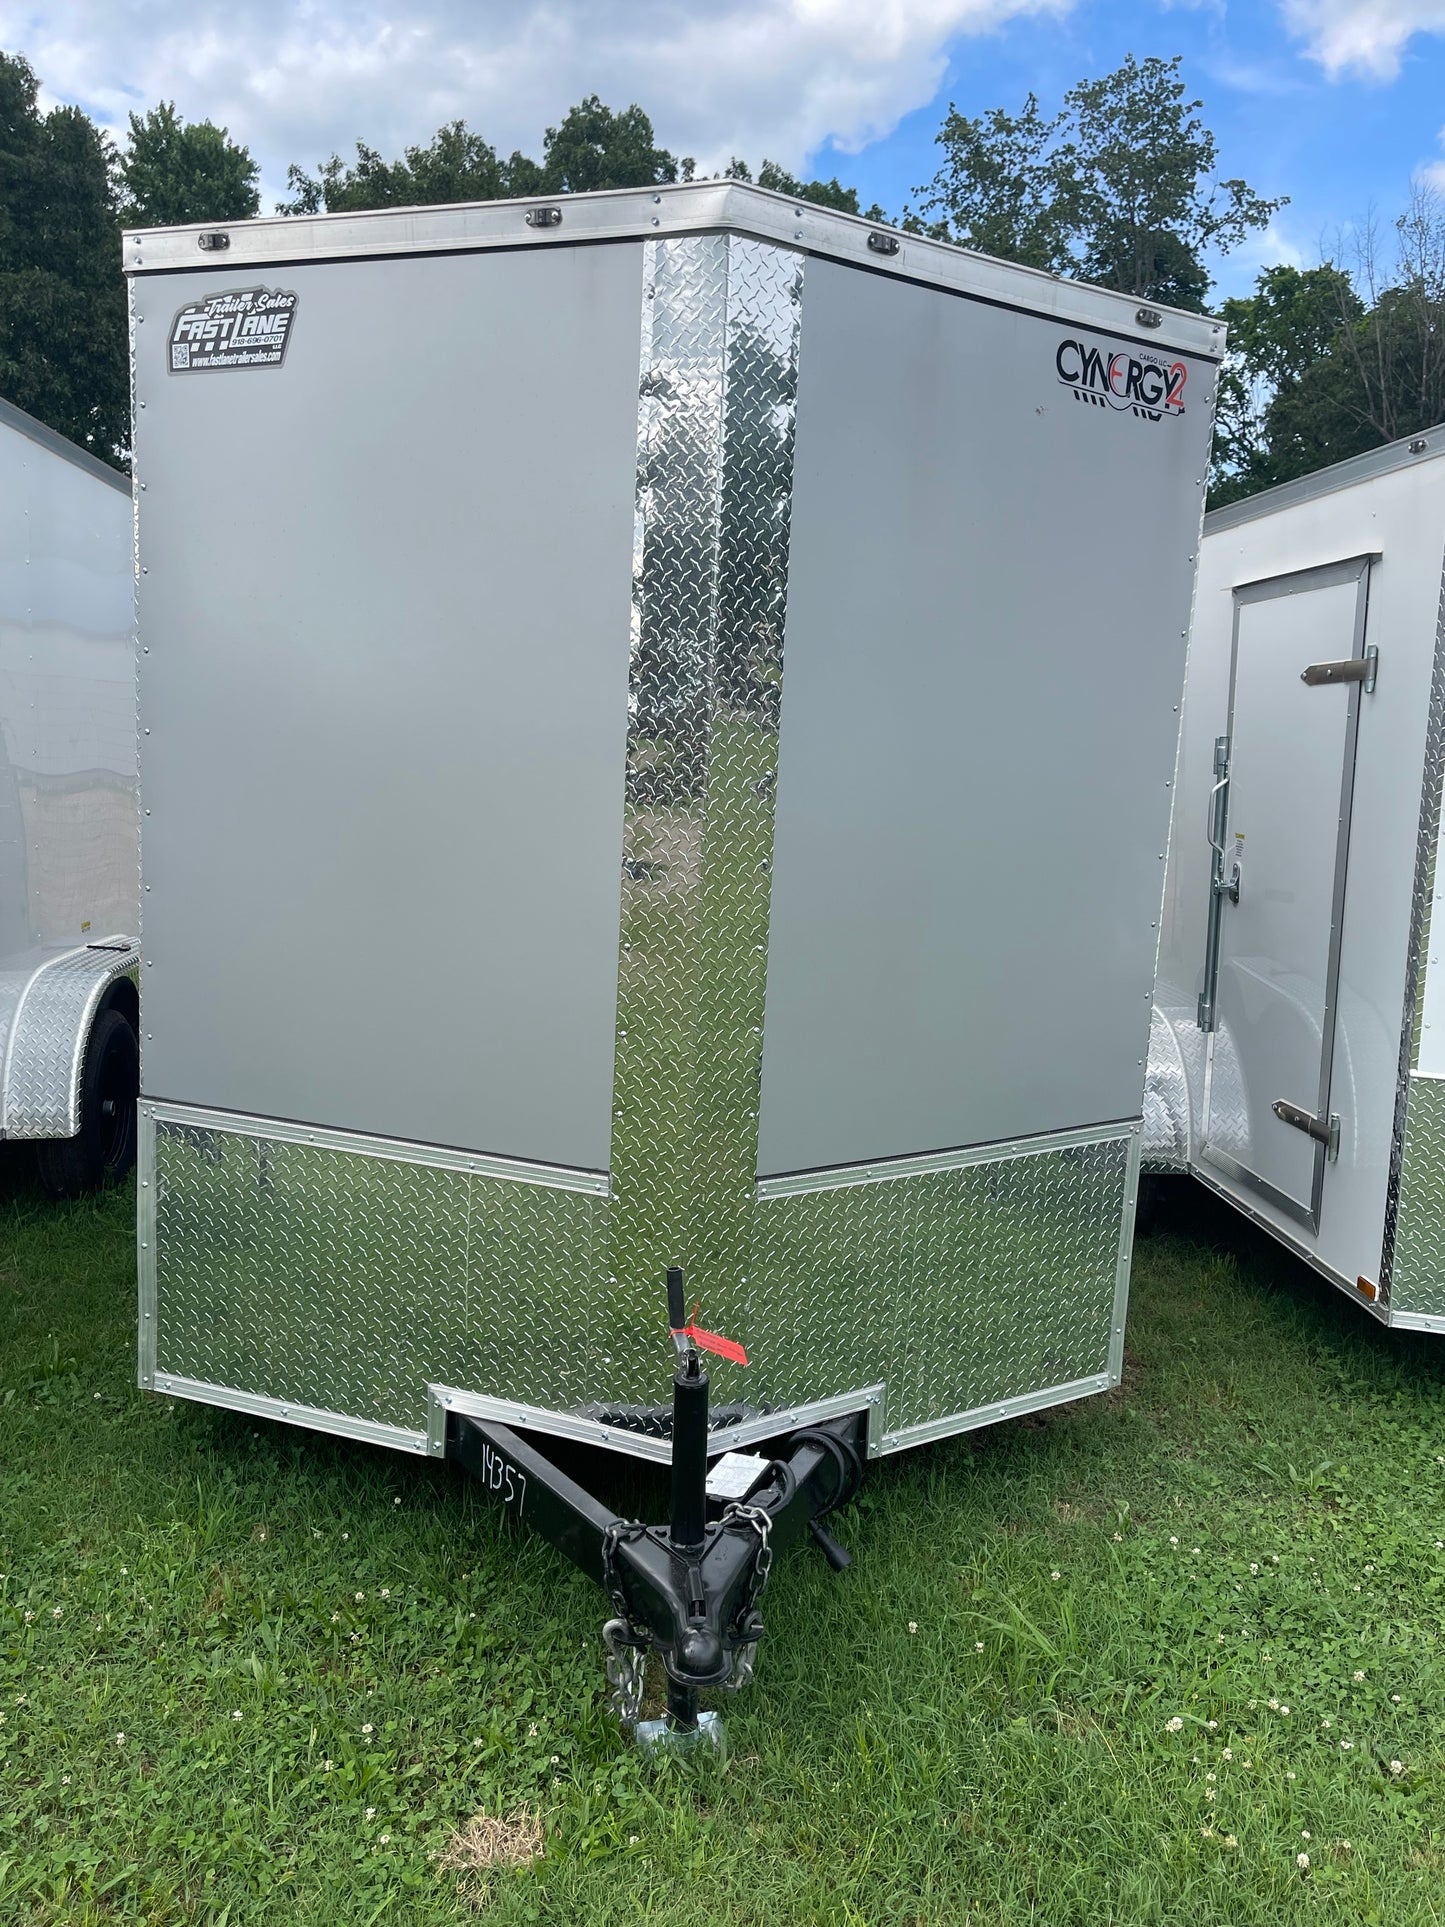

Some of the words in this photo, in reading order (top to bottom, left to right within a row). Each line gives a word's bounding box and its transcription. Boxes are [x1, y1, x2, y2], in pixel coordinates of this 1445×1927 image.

[207, 297, 254, 316] Trailer
[256, 294, 295, 312] Sales
[231, 335, 283, 346] 918-696-0701
[191, 349, 282, 367] www.fastlanetrailersales.com
[1139, 353, 1158, 364] CARGO
[482, 1443, 527, 1517] 14357
